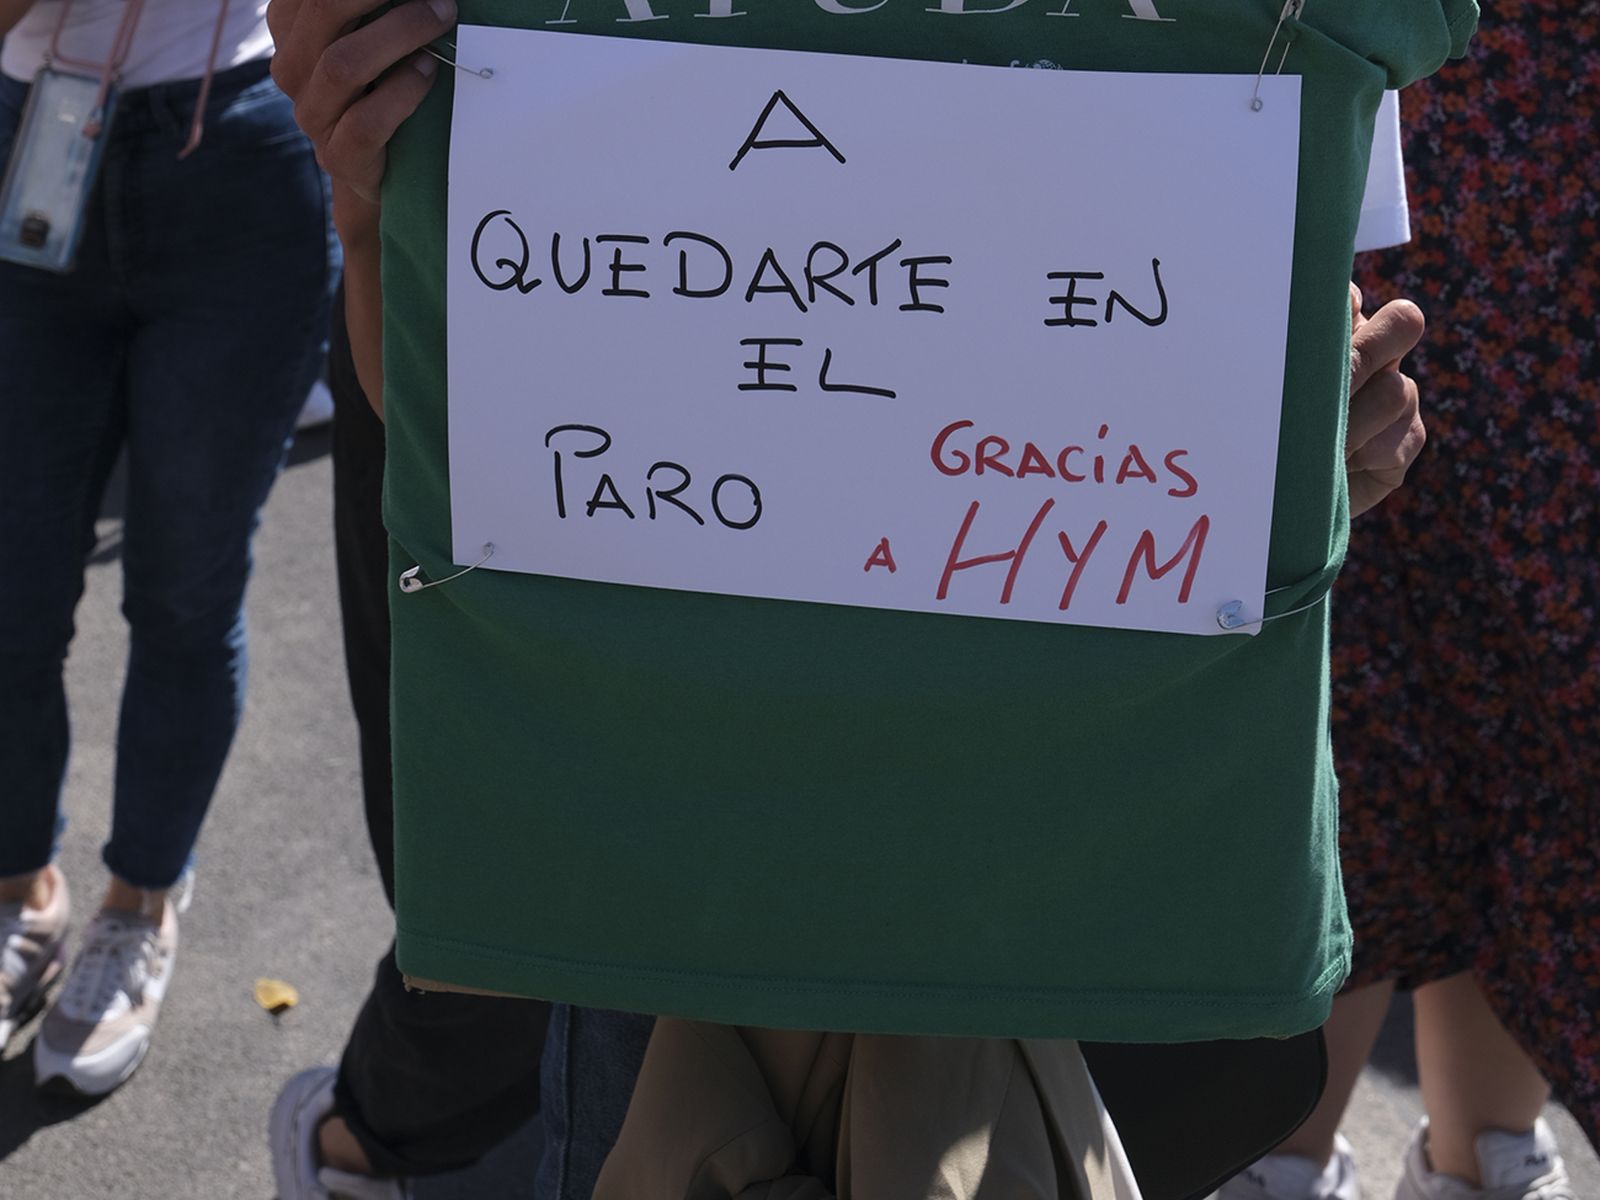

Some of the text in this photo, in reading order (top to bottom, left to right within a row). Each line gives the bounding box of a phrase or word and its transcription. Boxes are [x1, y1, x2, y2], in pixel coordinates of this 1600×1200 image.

[729, 90, 846, 171] A
[471, 210, 1167, 327] QUEDARTE EN
[738, 338, 896, 399] EL
[545, 424, 762, 530] PARO
[864, 497, 1210, 610] A HYM
